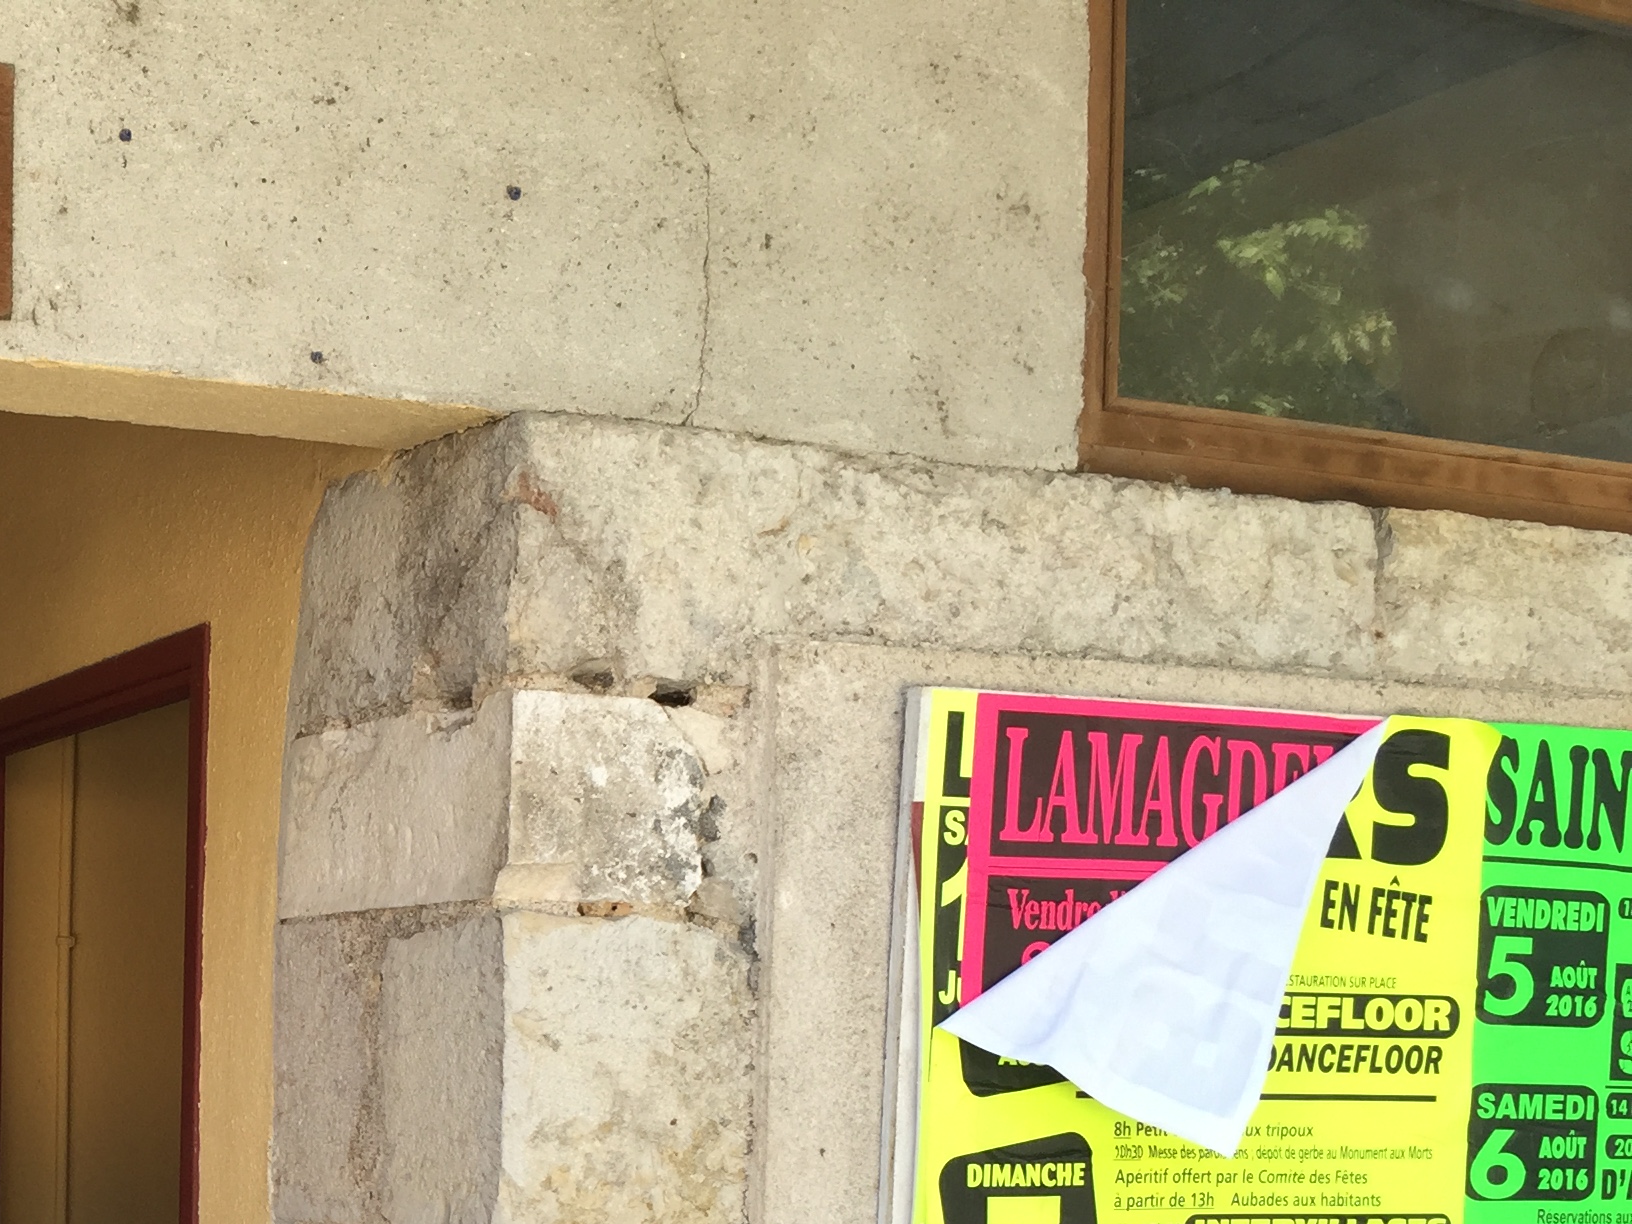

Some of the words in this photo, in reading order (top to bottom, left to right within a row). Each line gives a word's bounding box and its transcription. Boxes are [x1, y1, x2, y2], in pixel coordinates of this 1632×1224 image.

[999, 725, 1334, 853] LAMAGD
[1319, 879, 1361, 932] EN
[1367, 875, 1434, 943] FÊTE
[1486, 896, 1606, 933] VENDREDI
[1369, 976, 1396, 989] PLACE
[1484, 935, 1534, 1017] 5
[1549, 960, 1598, 990] AOÛT
[1545, 993, 1598, 1019] 2016
[1476, 1092, 1596, 1121] SAMEDI
[1113, 1120, 1131, 1137] 8h
[1265, 1123, 1314, 1140] tripoux
[1148, 1146, 1179, 1160] Messe
[1340, 1146, 1388, 1160] Monument
[1408, 1146, 1432, 1160] Morts
[1537, 1129, 1587, 1161] AOÛT
[966, 1162, 1086, 1188] DIMANCHE
[1115, 1168, 1169, 1186] Apéritif
[1172, 1169, 1211, 1184] offert
[1216, 1173, 1238, 1187] par
[1242, 1169, 1254, 1183] le
[1257, 1167, 1306, 1184] Comité
[1309, 1170, 1330, 1184] des
[1334, 1167, 1368, 1184] Fêtes
[1469, 1127, 1527, 1200] 6
[1537, 1167, 1589, 1191] 2016
[1126, 1193, 1165, 1211] partir
[1168, 1193, 1186, 1207] de
[1190, 1193, 1214, 1207] 13h
[1231, 1192, 1289, 1207] Aubades
[1292, 1195, 1316, 1207] aux
[1320, 1192, 1382, 1208] habitants
[1537, 1208, 1613, 1224] Réservations
